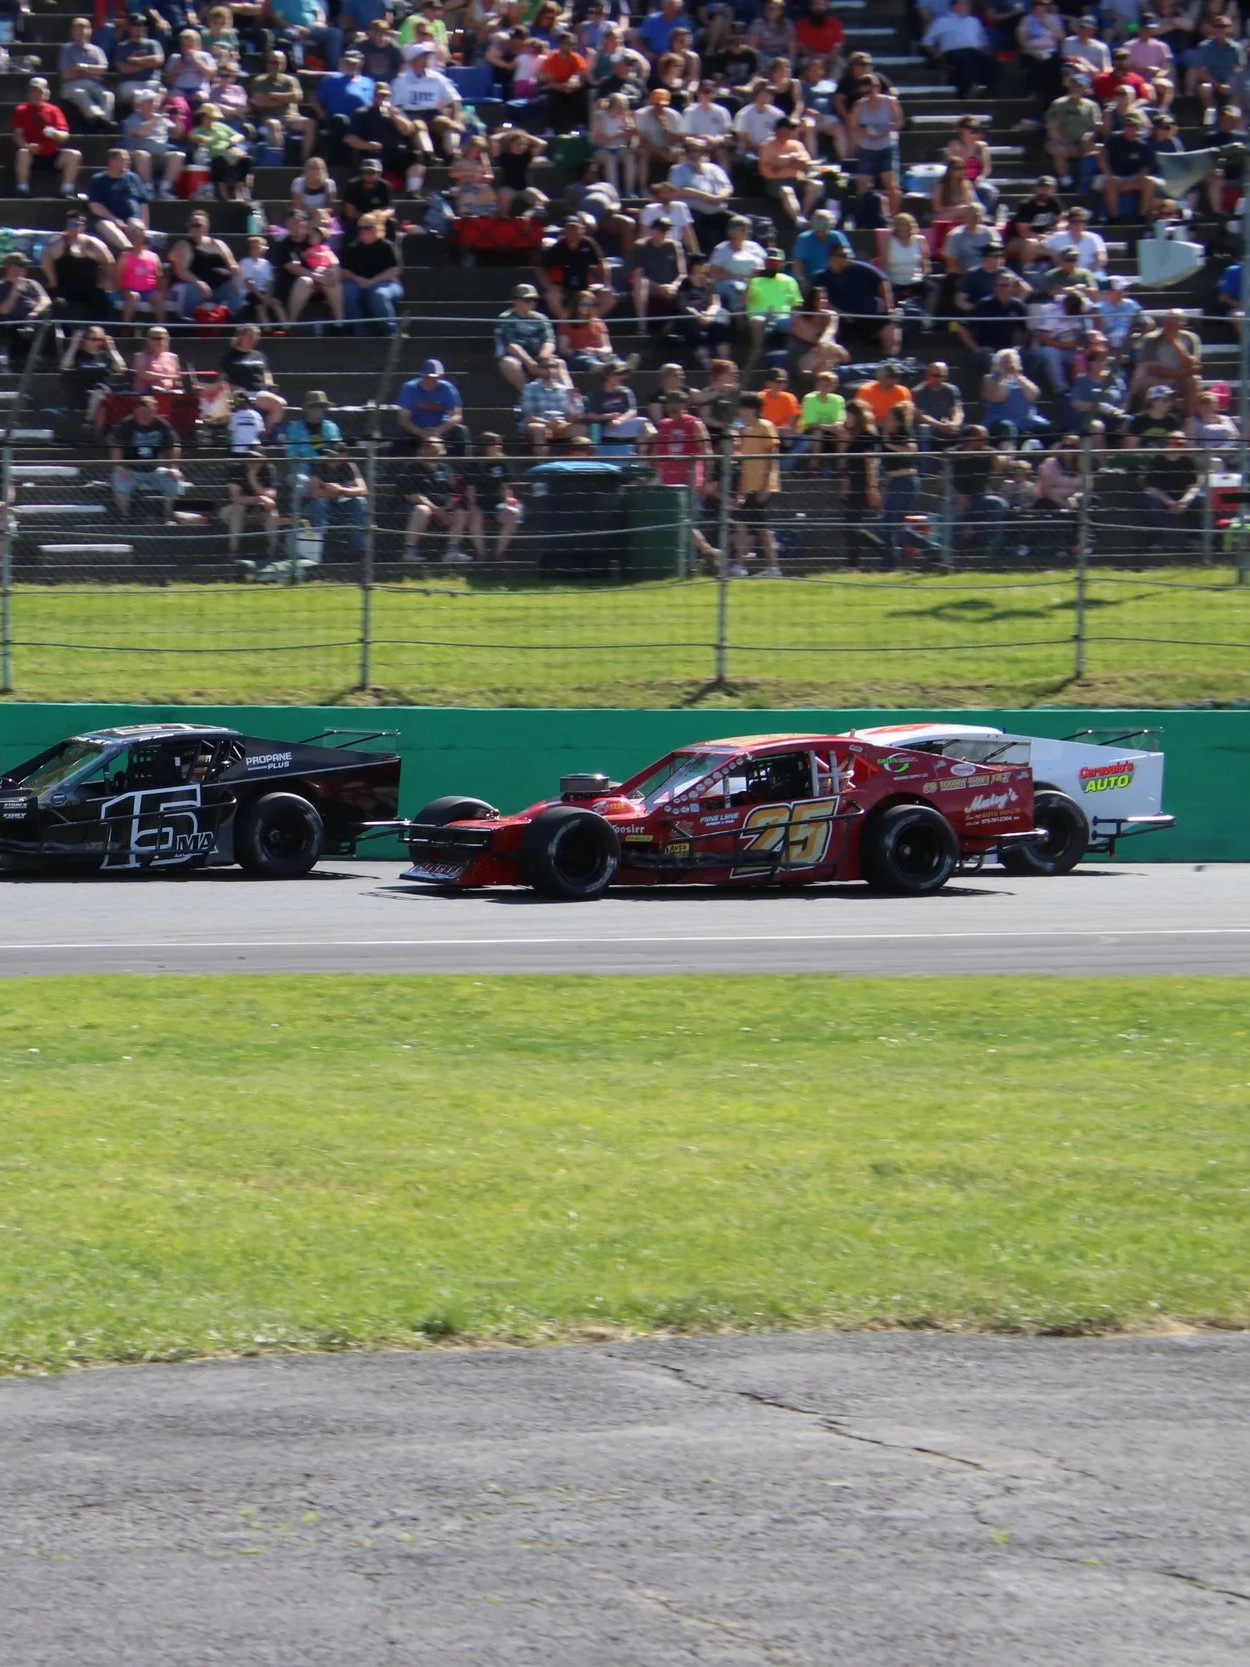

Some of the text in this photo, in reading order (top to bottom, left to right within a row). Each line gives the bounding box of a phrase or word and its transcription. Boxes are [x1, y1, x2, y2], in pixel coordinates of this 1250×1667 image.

[245, 751, 293, 766] PROPANE
[267, 760, 290, 770] PLUS
[1084, 774, 1132, 793] AUTO
[99, 783, 202, 870] 15
[729, 795, 840, 879] 25
[175, 831, 219, 857] MA
